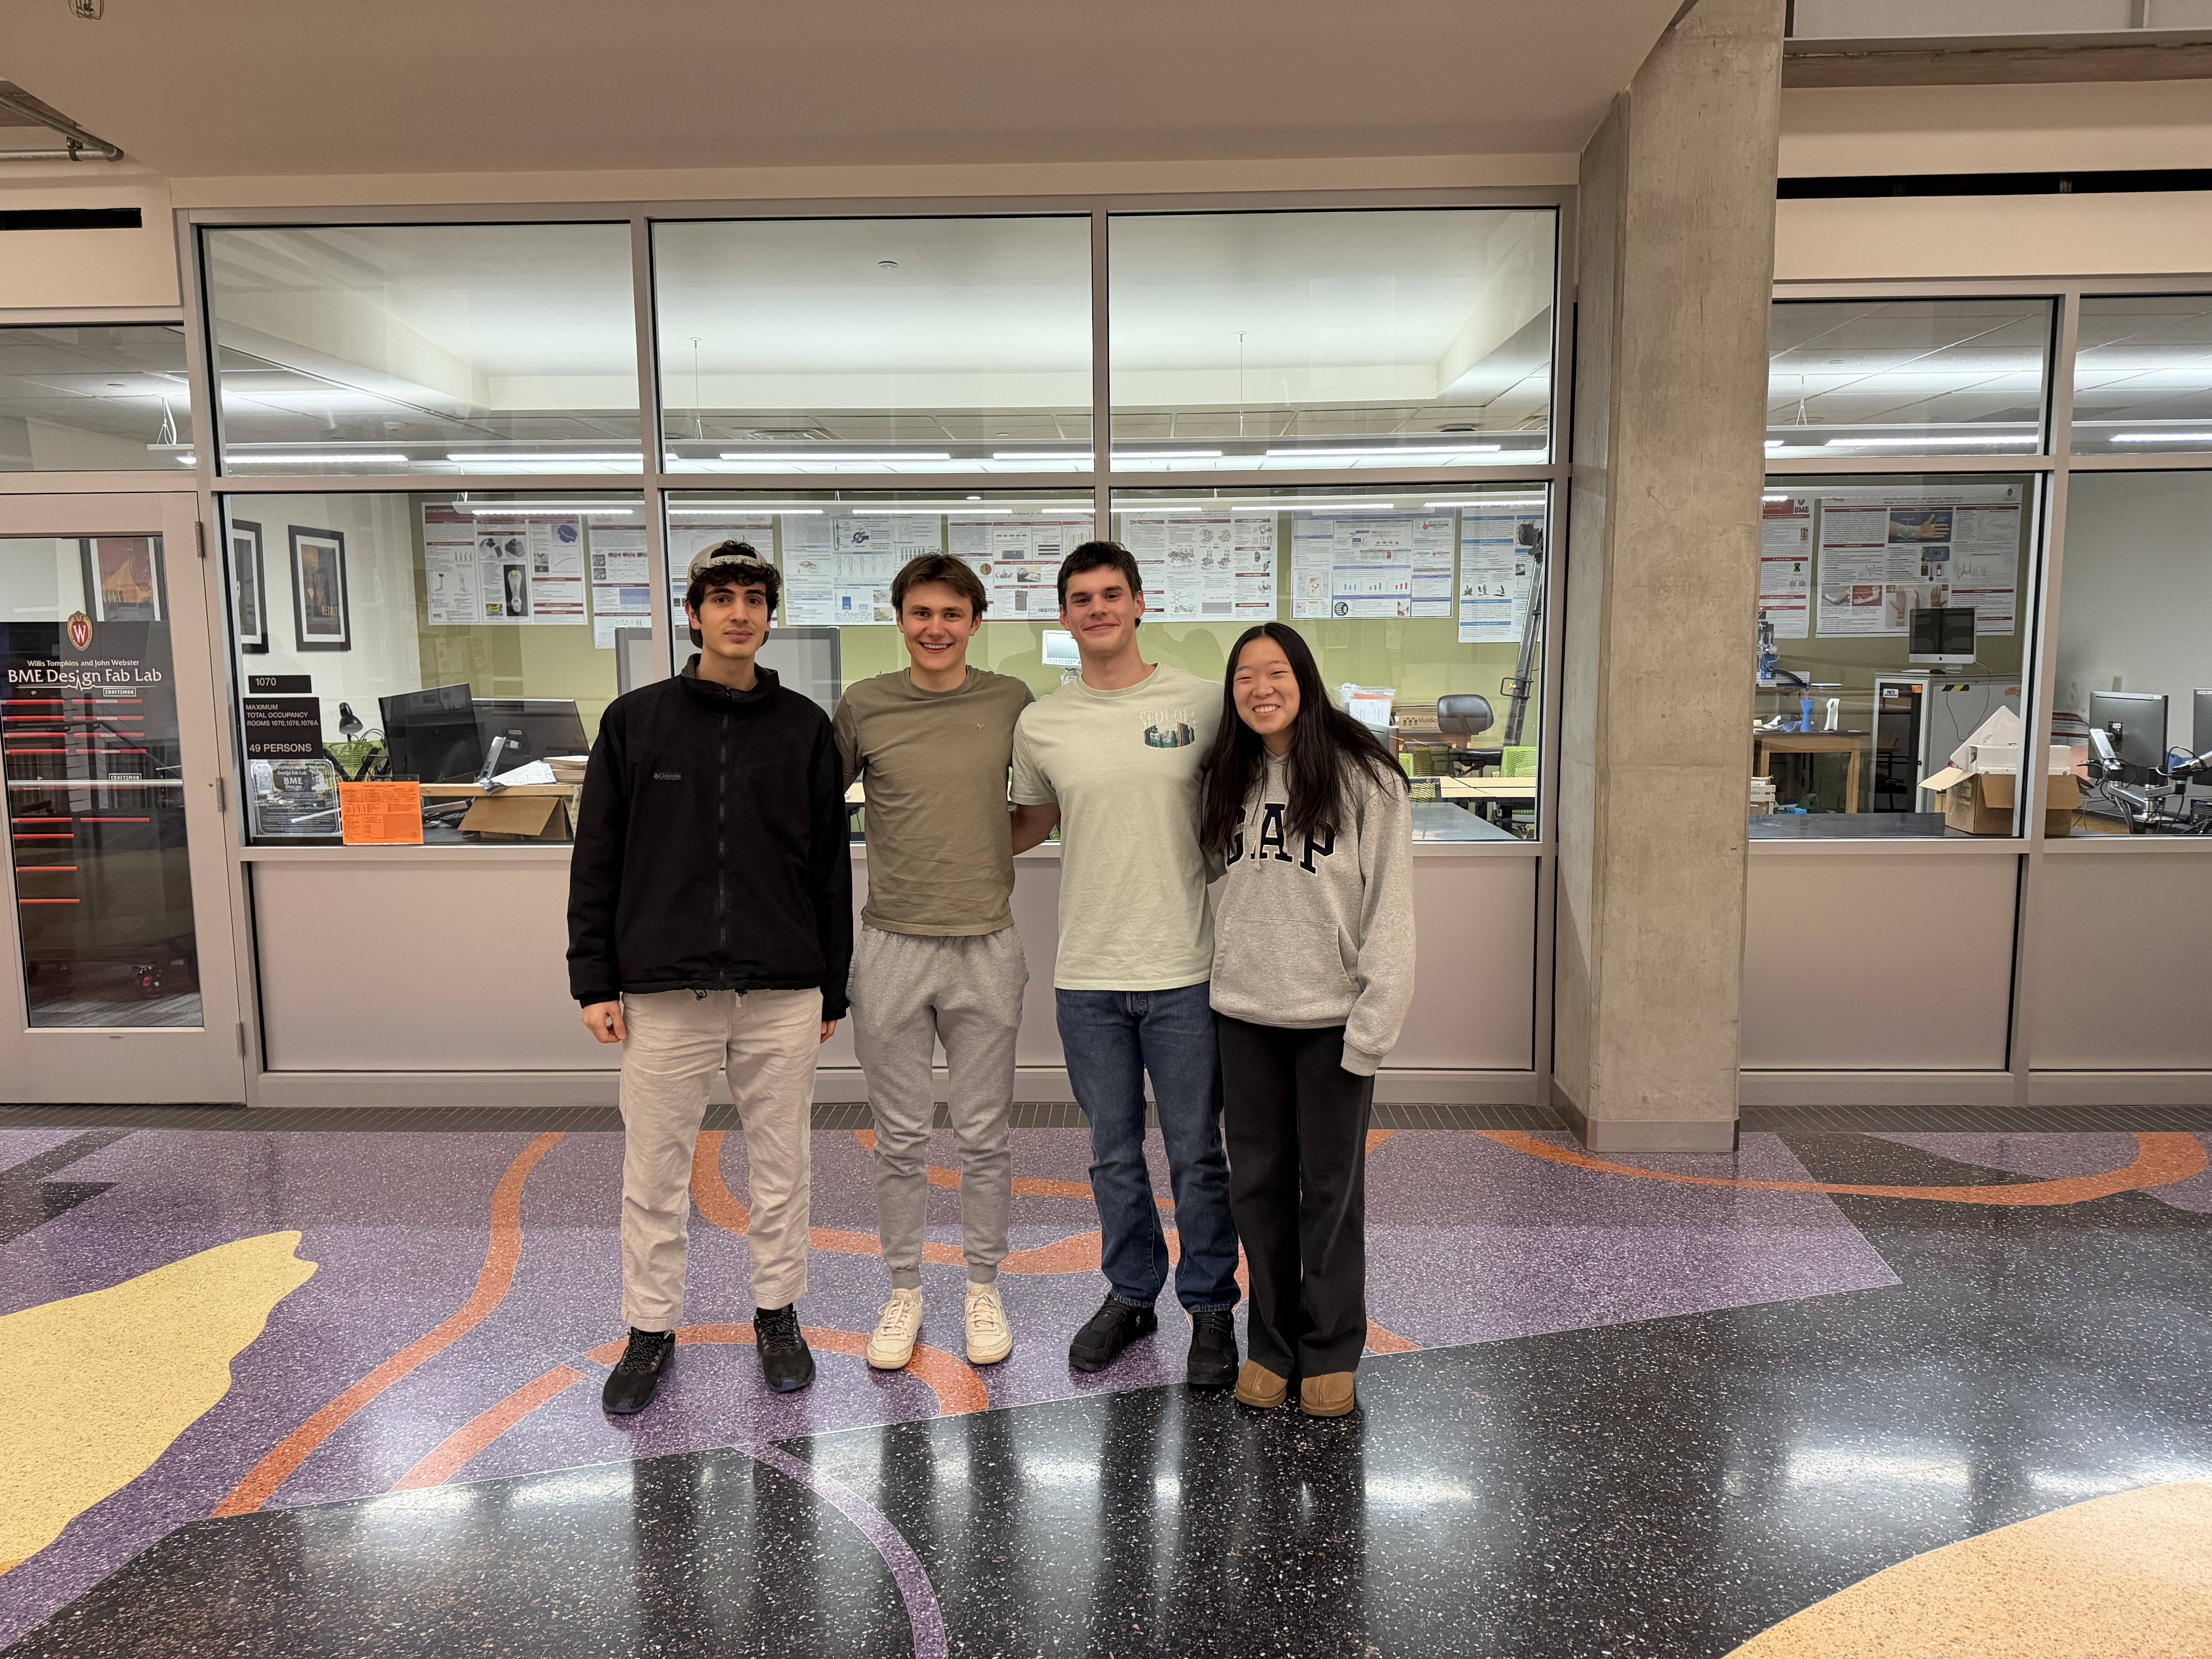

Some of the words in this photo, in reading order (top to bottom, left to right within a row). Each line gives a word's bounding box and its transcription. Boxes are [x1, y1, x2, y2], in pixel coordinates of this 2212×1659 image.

[46, 660, 79, 668] Tompkins
[94, 659, 110, 668] John
[8, 669, 44, 683] BME
[47, 669, 101, 687] Design
[106, 668, 130, 682] Fab
[135, 668, 162, 682] Lab
[255, 677, 276, 686] 1070
[249, 744, 261, 752] 49
[263, 743, 312, 752] PERSONS
[283, 777, 303, 785] BME
